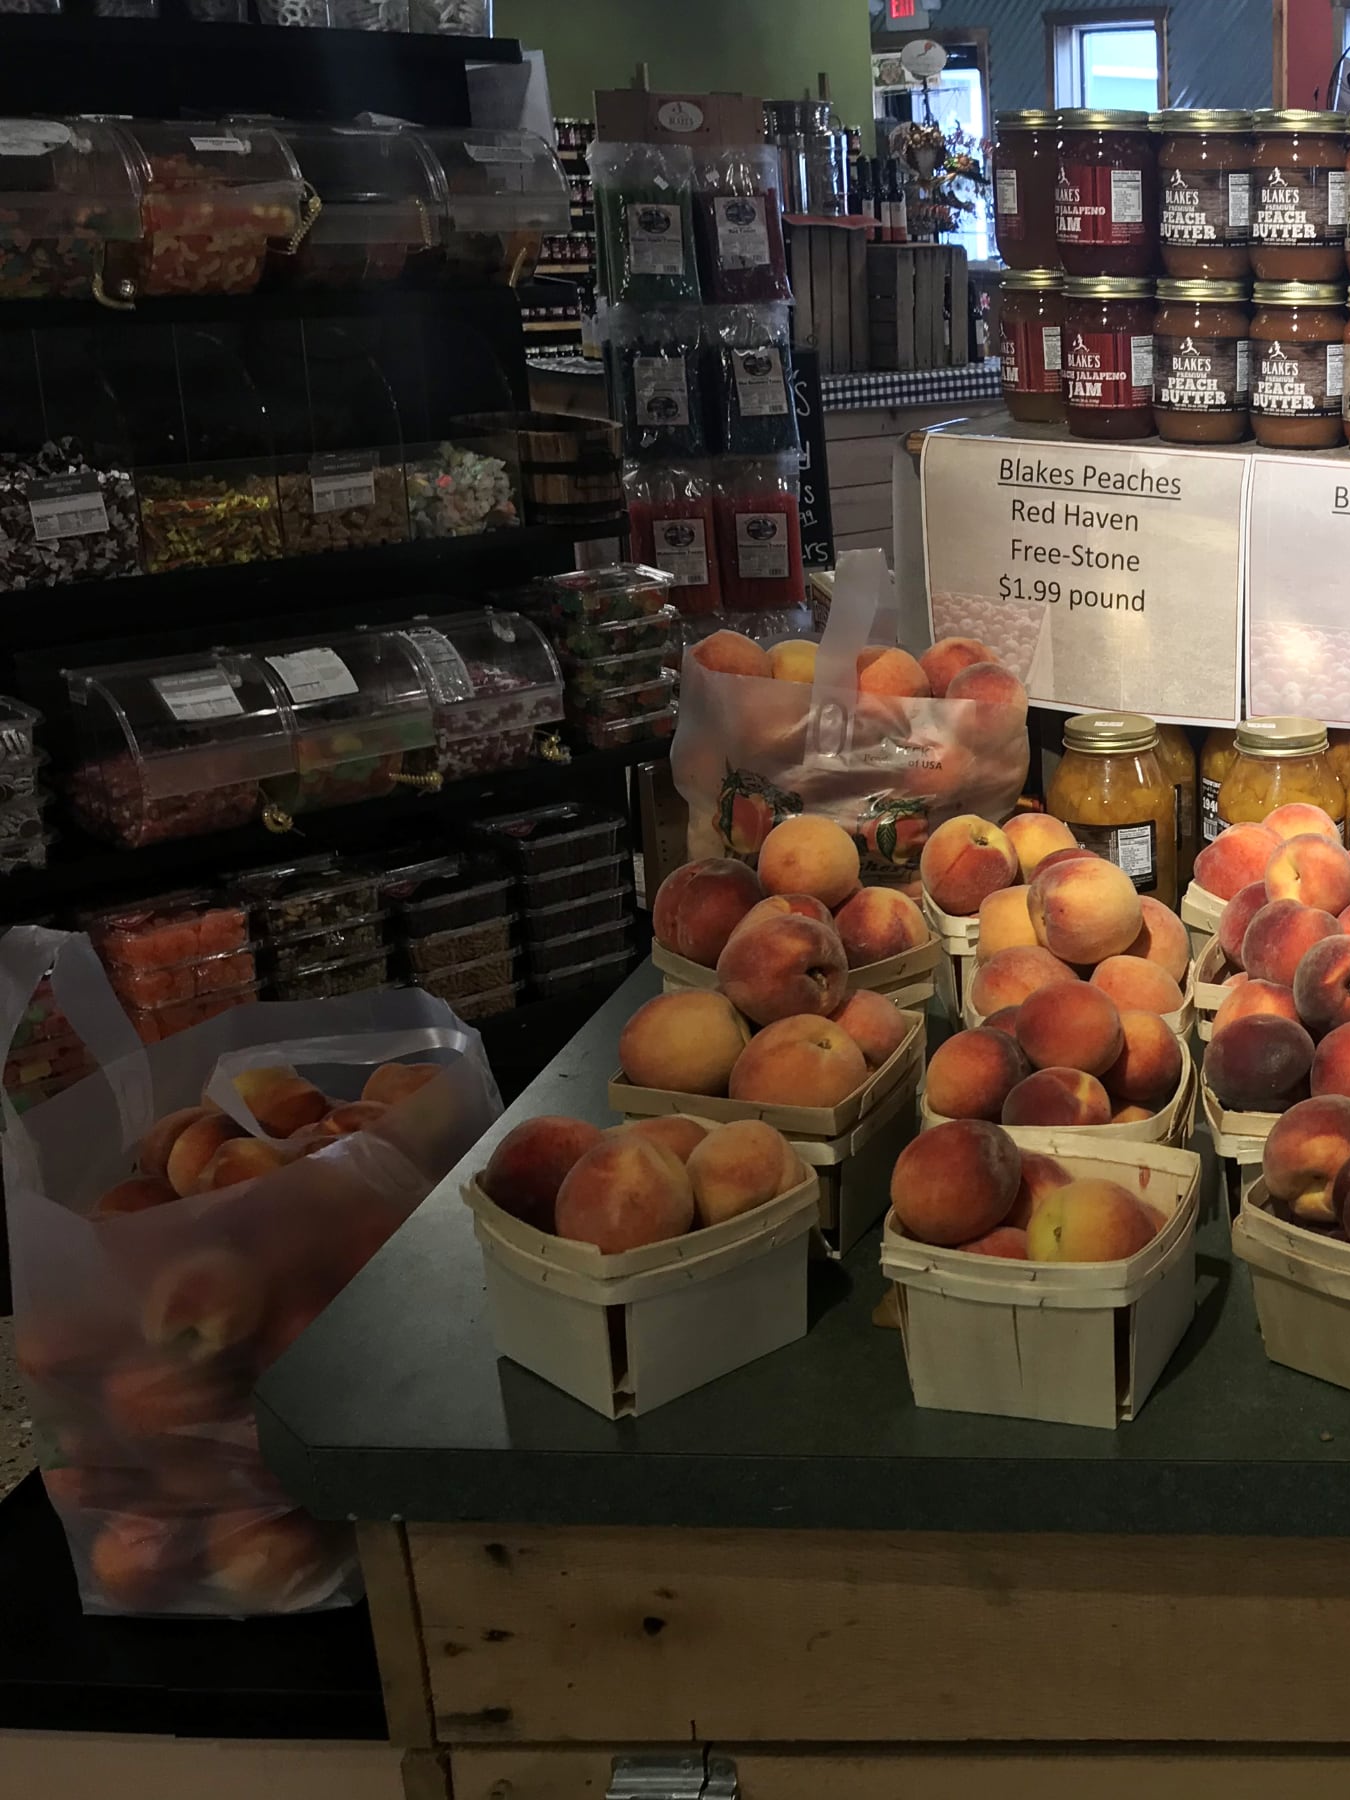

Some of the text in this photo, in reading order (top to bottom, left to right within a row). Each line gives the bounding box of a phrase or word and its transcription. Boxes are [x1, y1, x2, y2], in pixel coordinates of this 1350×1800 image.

[1165, 190, 1199, 205] BLAKE'S
[1261, 189, 1299, 203] BLAKE'S
[1060, 205, 1106, 216] JALAPENO
[1163, 211, 1206, 225] PEACH
[1257, 211, 1307, 224] PEACH
[1056, 216, 1082, 234] JAM
[1160, 223, 1217, 239] BUTTER
[1252, 223, 1317, 239] BUTTER
[1067, 354, 1101, 368] BLAKE'S
[1172, 357, 1211, 372] BLAKE'S
[1262, 361, 1299, 376] BLAKE'S
[1001, 367, 1019, 382] AM
[1076, 371, 1127, 381] JALAPENO
[1068, 382, 1103, 399] JAM
[1168, 377, 1218, 391] PEACH
[1257, 381, 1306, 395] PEACH
[1161, 388, 1227, 405] BUTTER
[1253, 393, 1316, 409] BUTTER
[1000, 458, 1181, 494] Blakes Peaches
[1012, 499, 1138, 531] Red Haven
[1011, 539, 1140, 571] Free-Stone
[999, 573, 1145, 612] $1.99 pound
[908, 760, 943, 770] of USA
